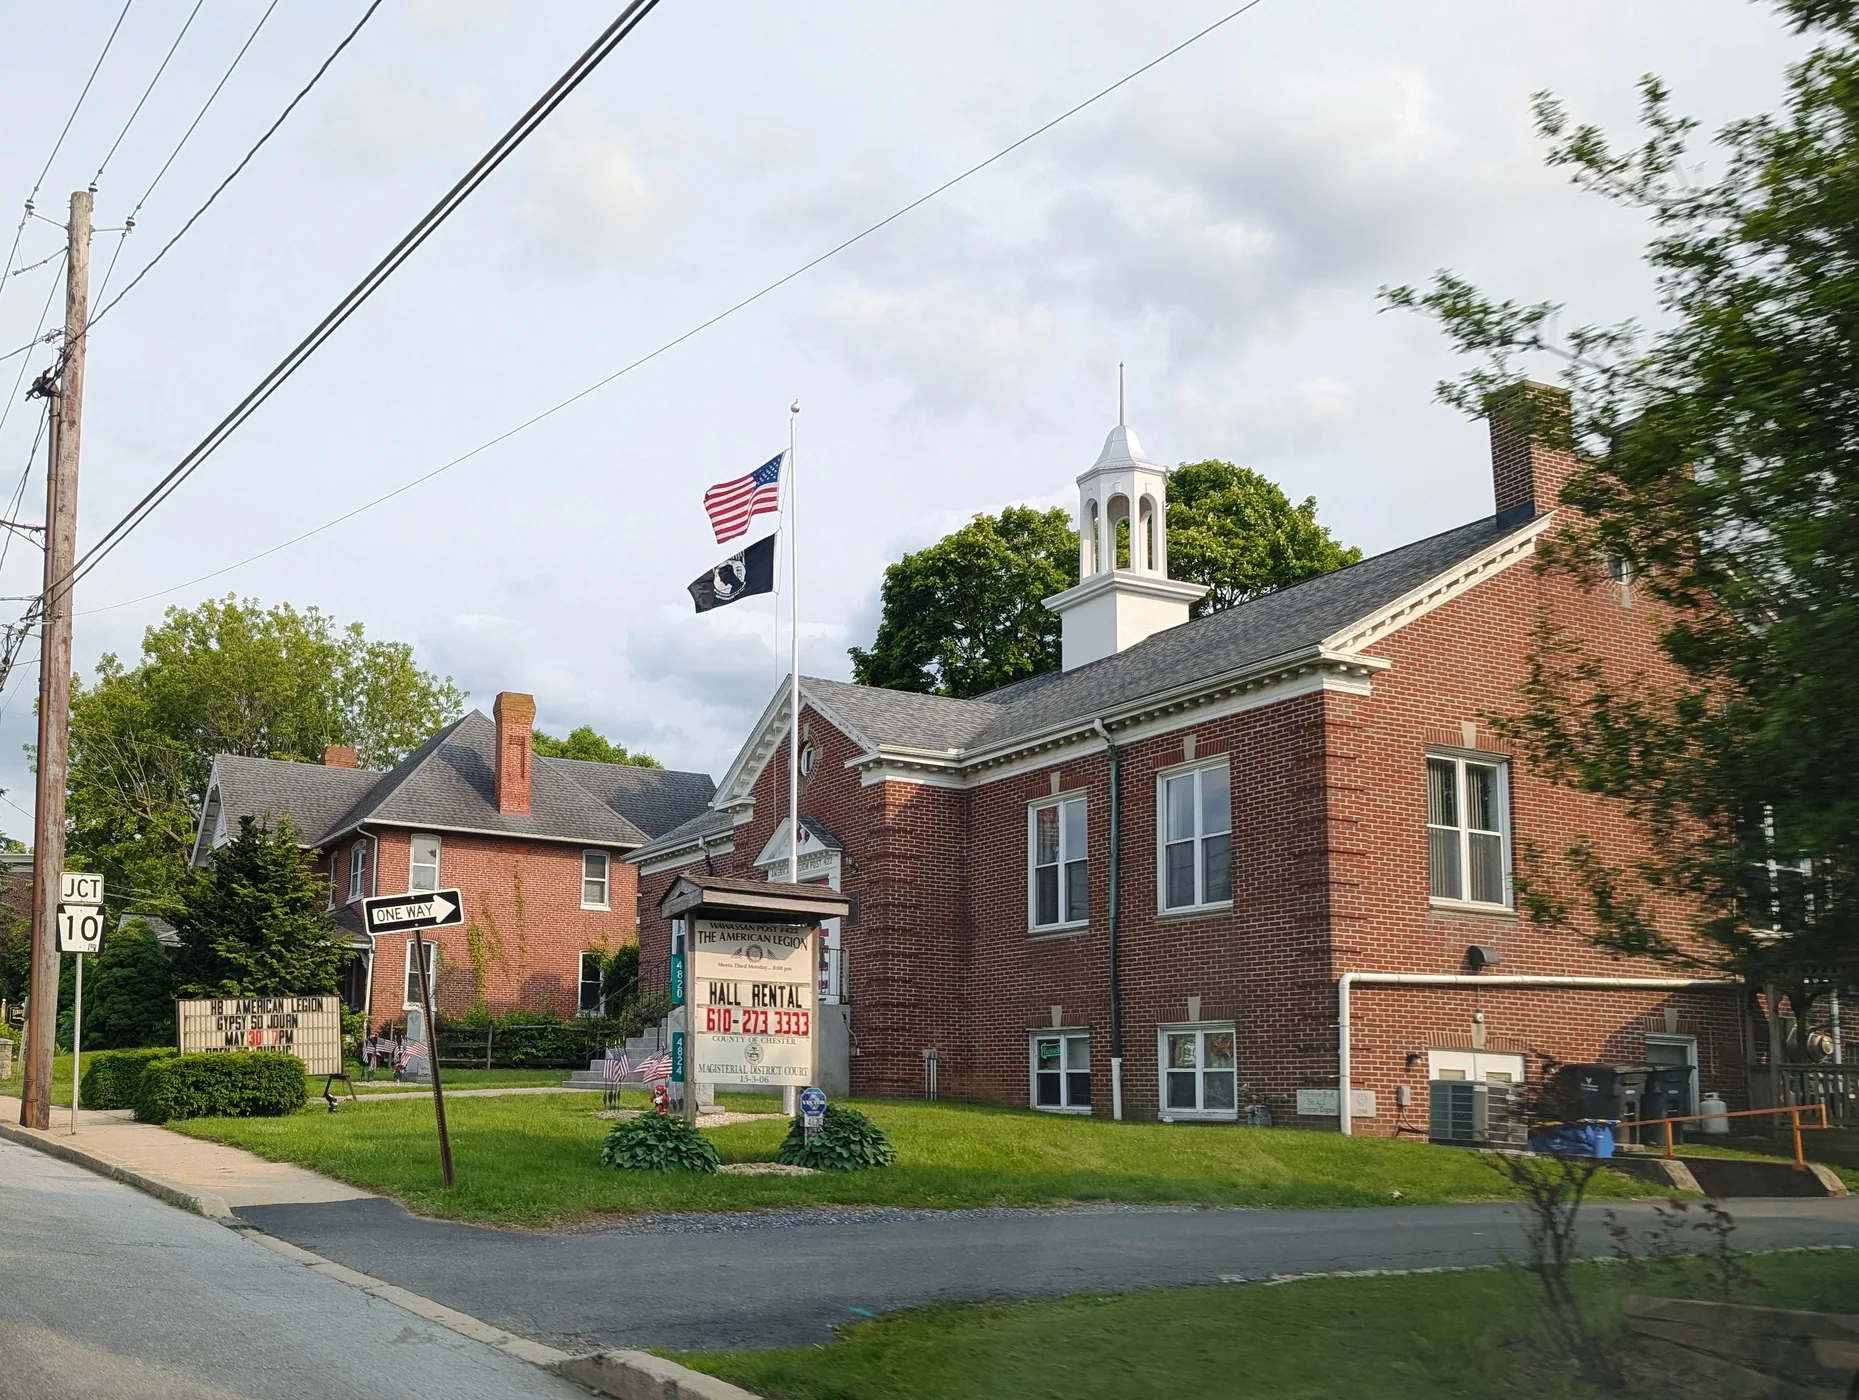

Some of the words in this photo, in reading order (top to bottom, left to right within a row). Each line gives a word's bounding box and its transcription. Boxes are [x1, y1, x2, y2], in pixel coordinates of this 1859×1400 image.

[64, 878, 101, 898] JCT
[376, 907, 403, 922] ONE
[406, 903, 433, 919] WAY
[67, 915, 99, 942] 10
[710, 922, 755, 931] WAWASSAN
[757, 925, 777, 933] POST
[698, 930, 716, 944] THE
[719, 932, 771, 943] AMERICAN
[773, 934, 808, 951] LEGION
[709, 982, 742, 1006] HALL
[752, 984, 802, 1009] RENTAL
[235, 1000, 284, 1014] AMERICAN
[291, 998, 323, 1013] LEGION
[217, 1015, 247, 1031] GYPSY
[250, 1014, 264, 1029] SO
[267, 1013, 298, 1029] JOURN
[774, 1011, 809, 1036] 3333
[225, 1031, 245, 1046] MAY
[248, 1030, 263, 1045] 30
[712, 1035, 745, 1043] COUNTY
[760, 1037, 796, 1045] CHESTER
[676, 1037, 684, 1075] 4824
[698, 1063, 748, 1074] MAGISTERIAL
[750, 1065, 782, 1076] DISTRICT
[784, 1066, 809, 1076] COURT
[740, 1075, 770, 1083] 15-3-06
